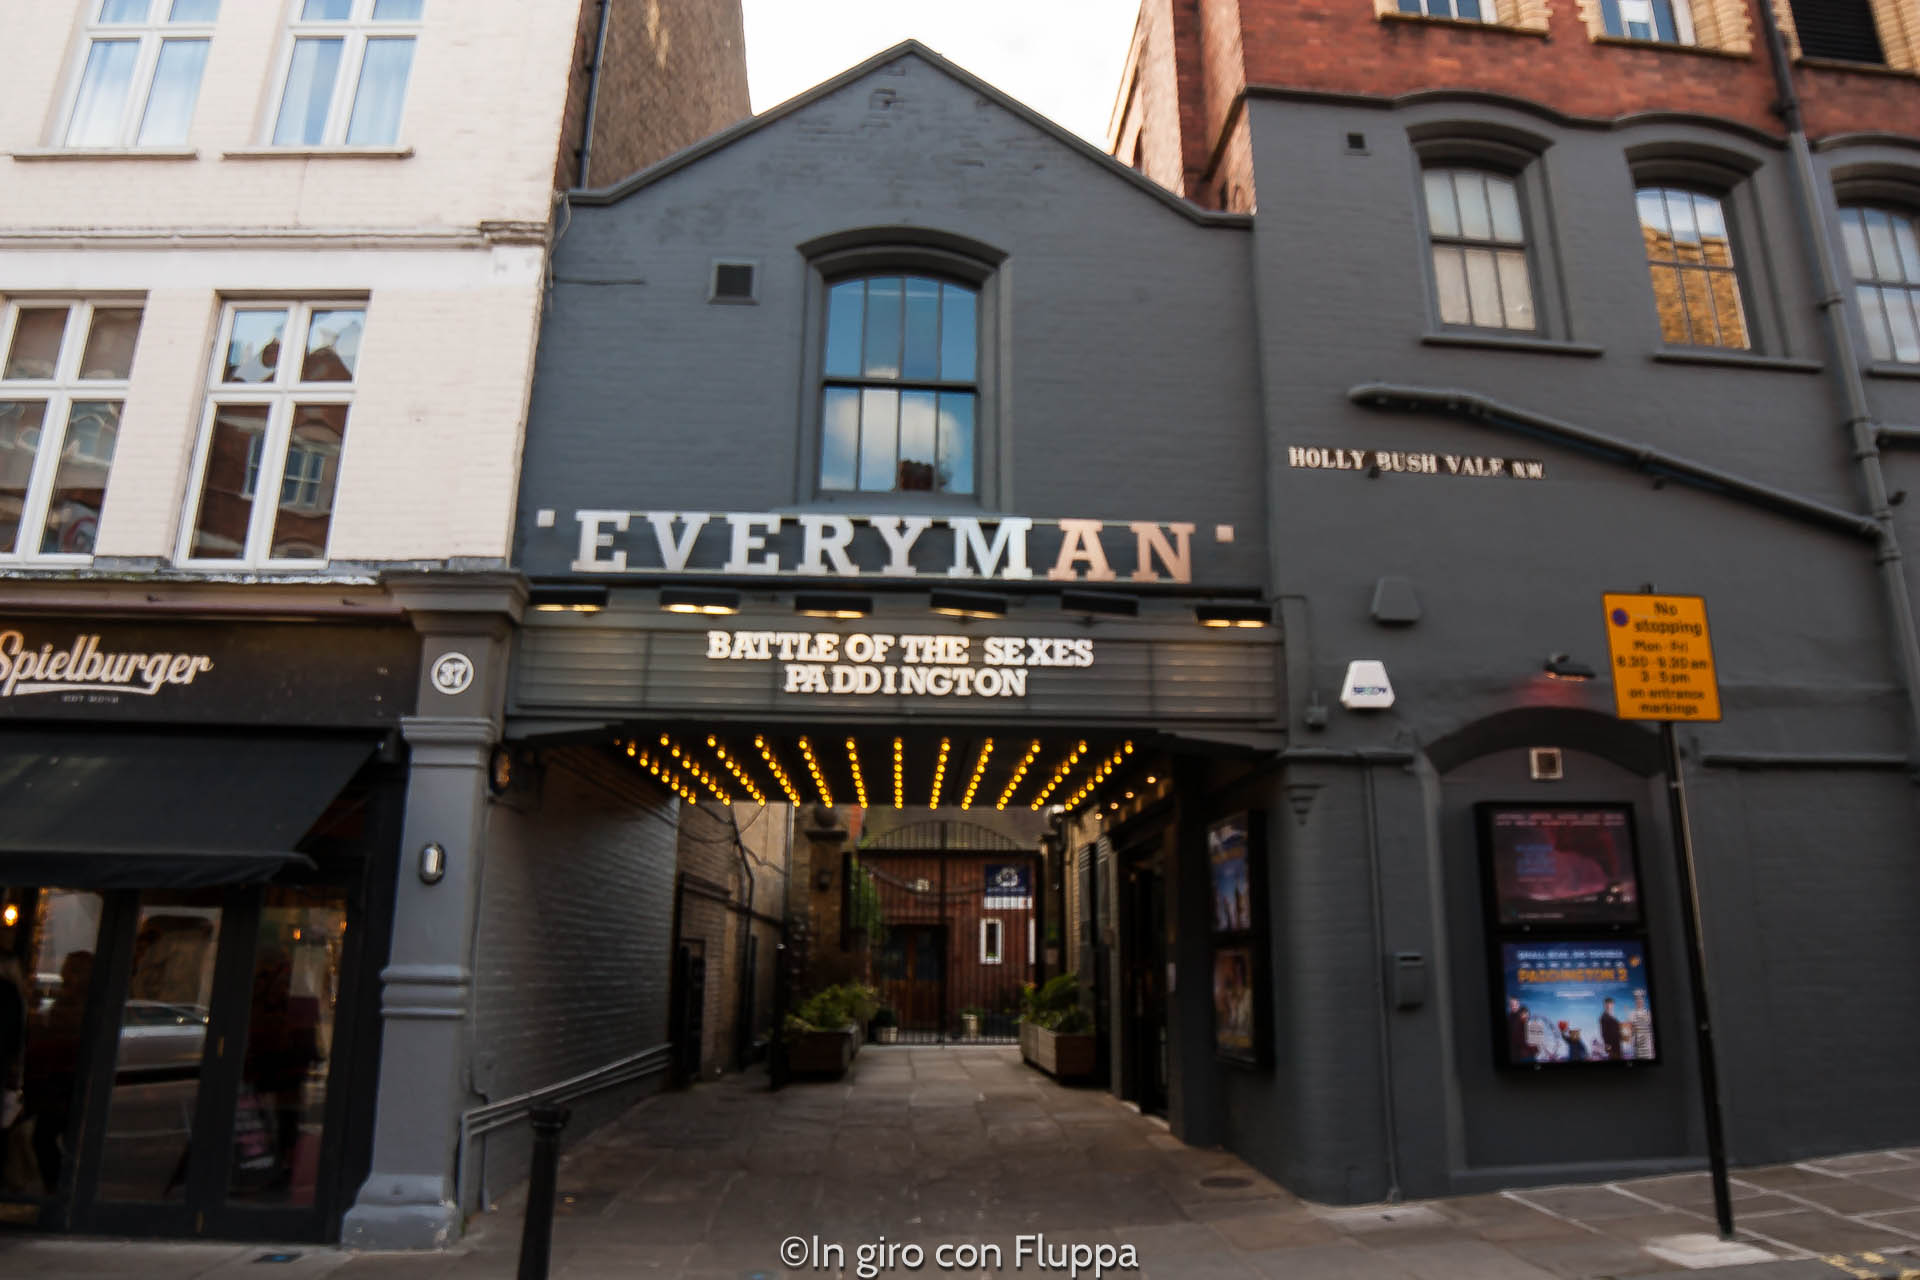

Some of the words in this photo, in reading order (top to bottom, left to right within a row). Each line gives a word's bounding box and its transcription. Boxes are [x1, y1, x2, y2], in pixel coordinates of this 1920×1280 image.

[1288, 446, 1365, 470] HOLLY
[1376, 451, 1438, 474] BUSH
[571, 510, 1195, 583] EVERYMAN
[1654, 602, 1678, 616] No
[1635, 619, 1703, 637] stopping
[0, 630, 215, 697] Spielburger
[706, 630, 840, 662] BATTLE
[844, 633, 896, 663] OF
[901, 634, 970, 665] THE
[983, 637, 1094, 667] SEXES
[784, 664, 1029, 697] PADDINGTON
